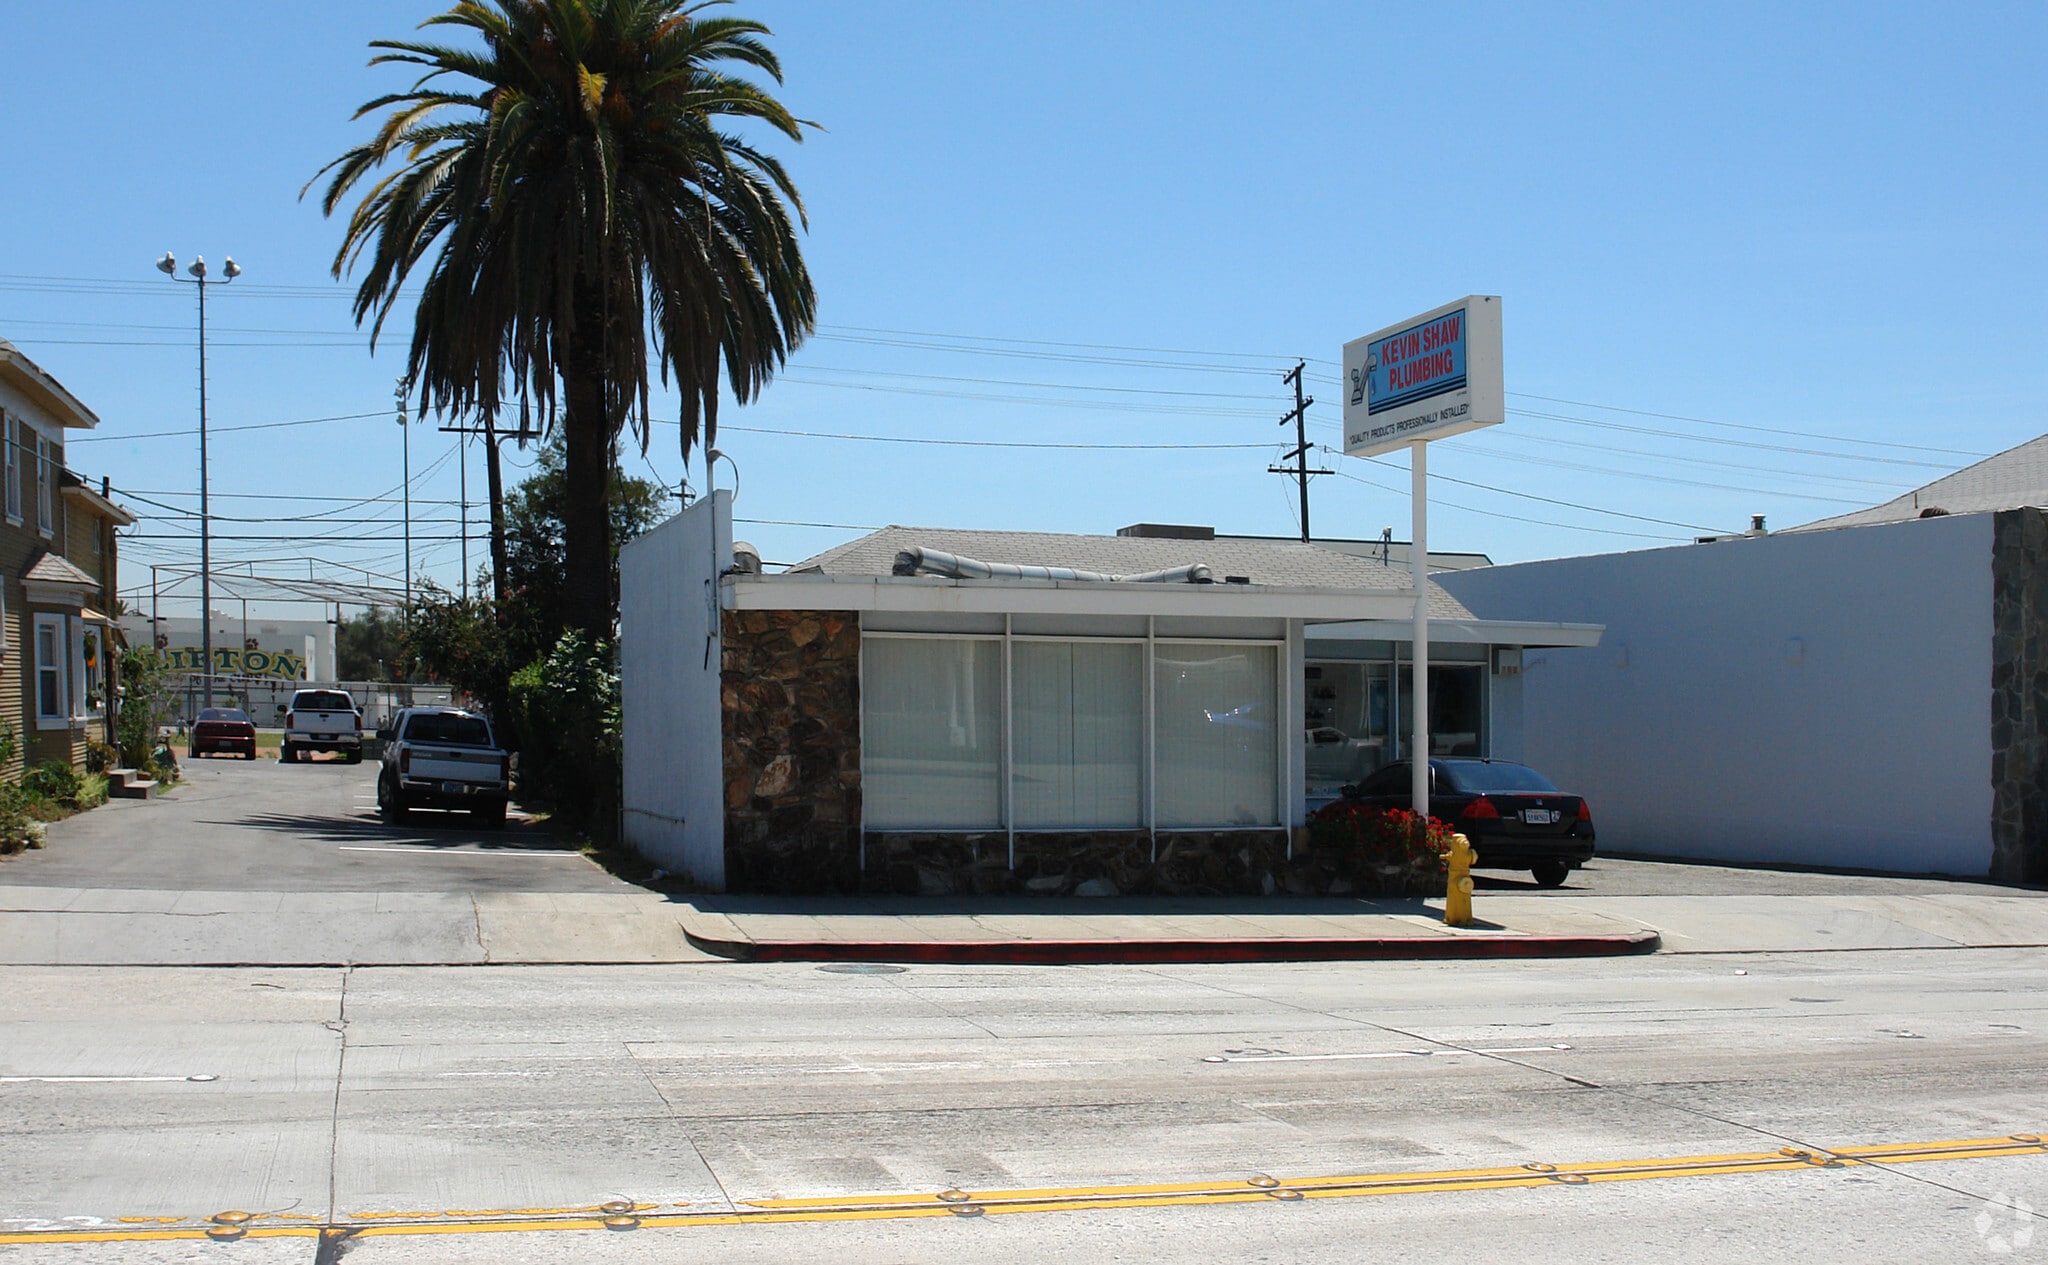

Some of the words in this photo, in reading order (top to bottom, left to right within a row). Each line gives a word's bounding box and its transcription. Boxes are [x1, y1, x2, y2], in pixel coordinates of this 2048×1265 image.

[1382, 332, 1420, 367] KEVIN
[1423, 316, 1460, 353] SHAW
[1389, 349, 1453, 392] PLUMBING
[1371, 423, 1396, 440] PRODUCTS
[1396, 412, 1438, 432] PROFESSIONALLY
